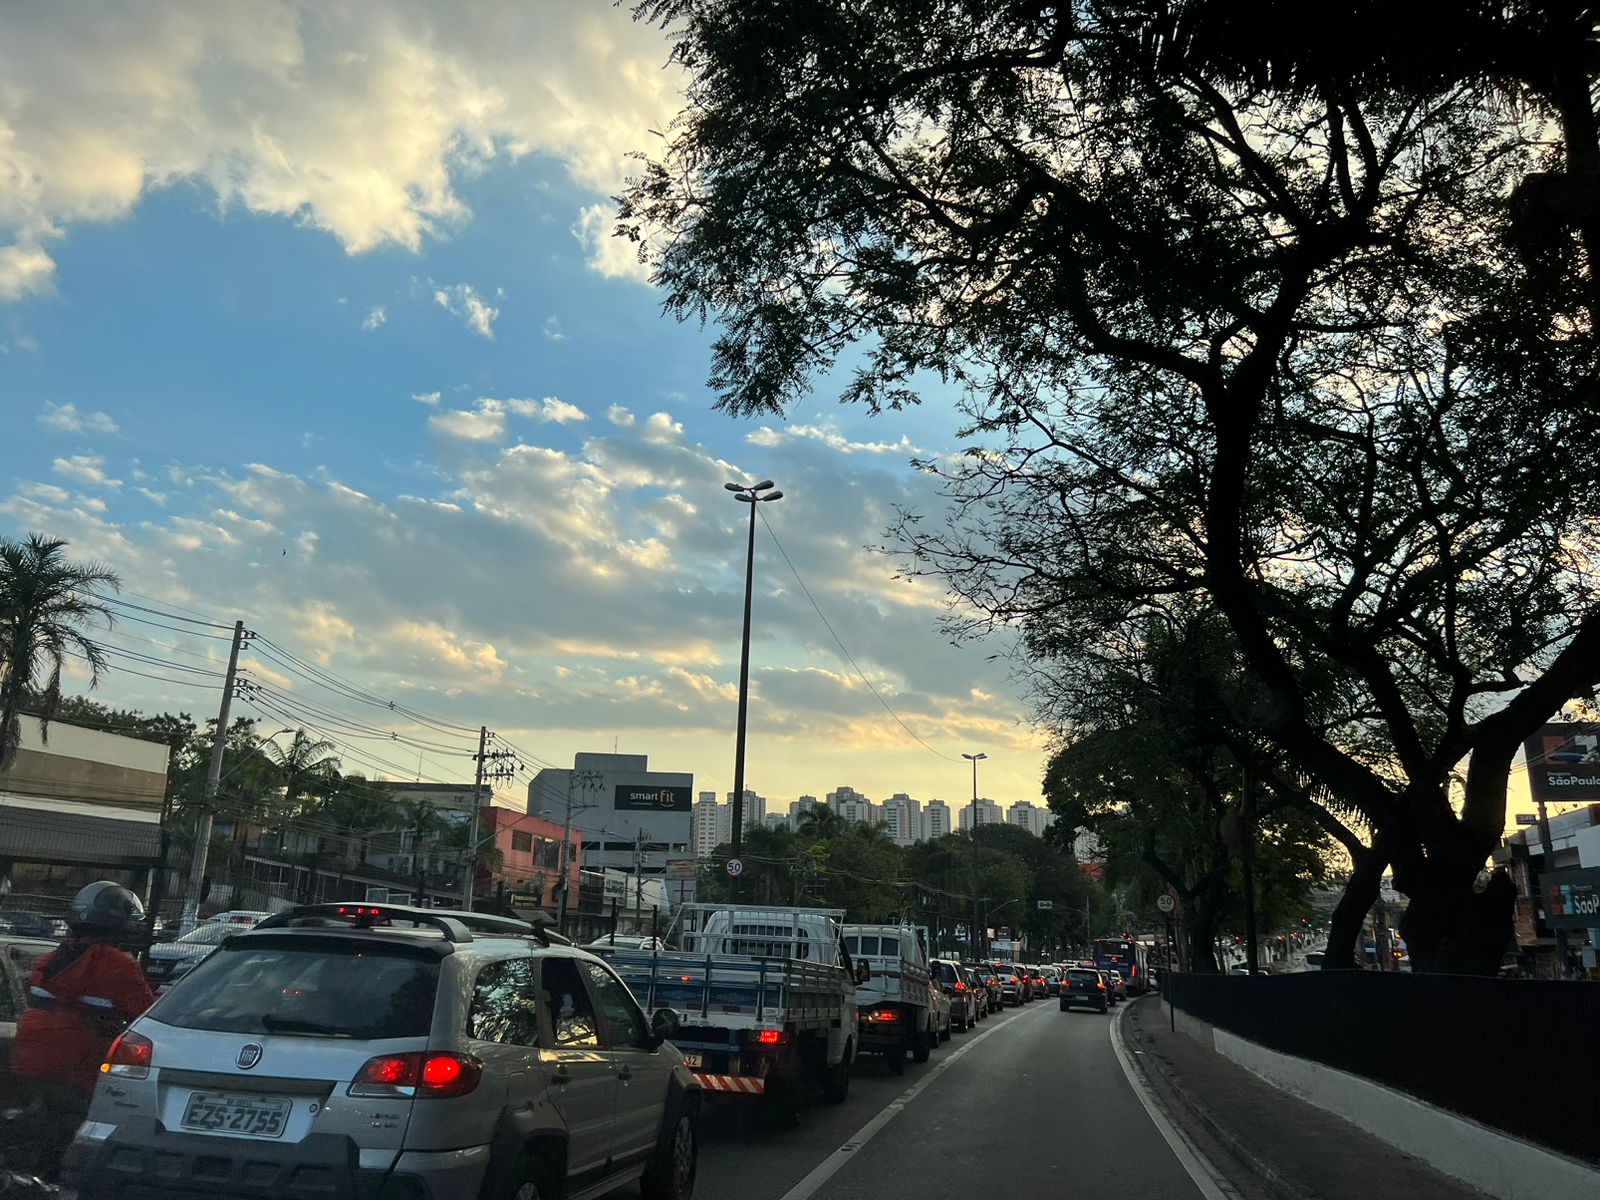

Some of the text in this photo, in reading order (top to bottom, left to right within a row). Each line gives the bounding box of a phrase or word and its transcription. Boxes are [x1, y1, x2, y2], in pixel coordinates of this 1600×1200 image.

[630, 792, 658, 801] smart
[728, 862, 741, 872] 50
[1160, 896, 1172, 906] 50
